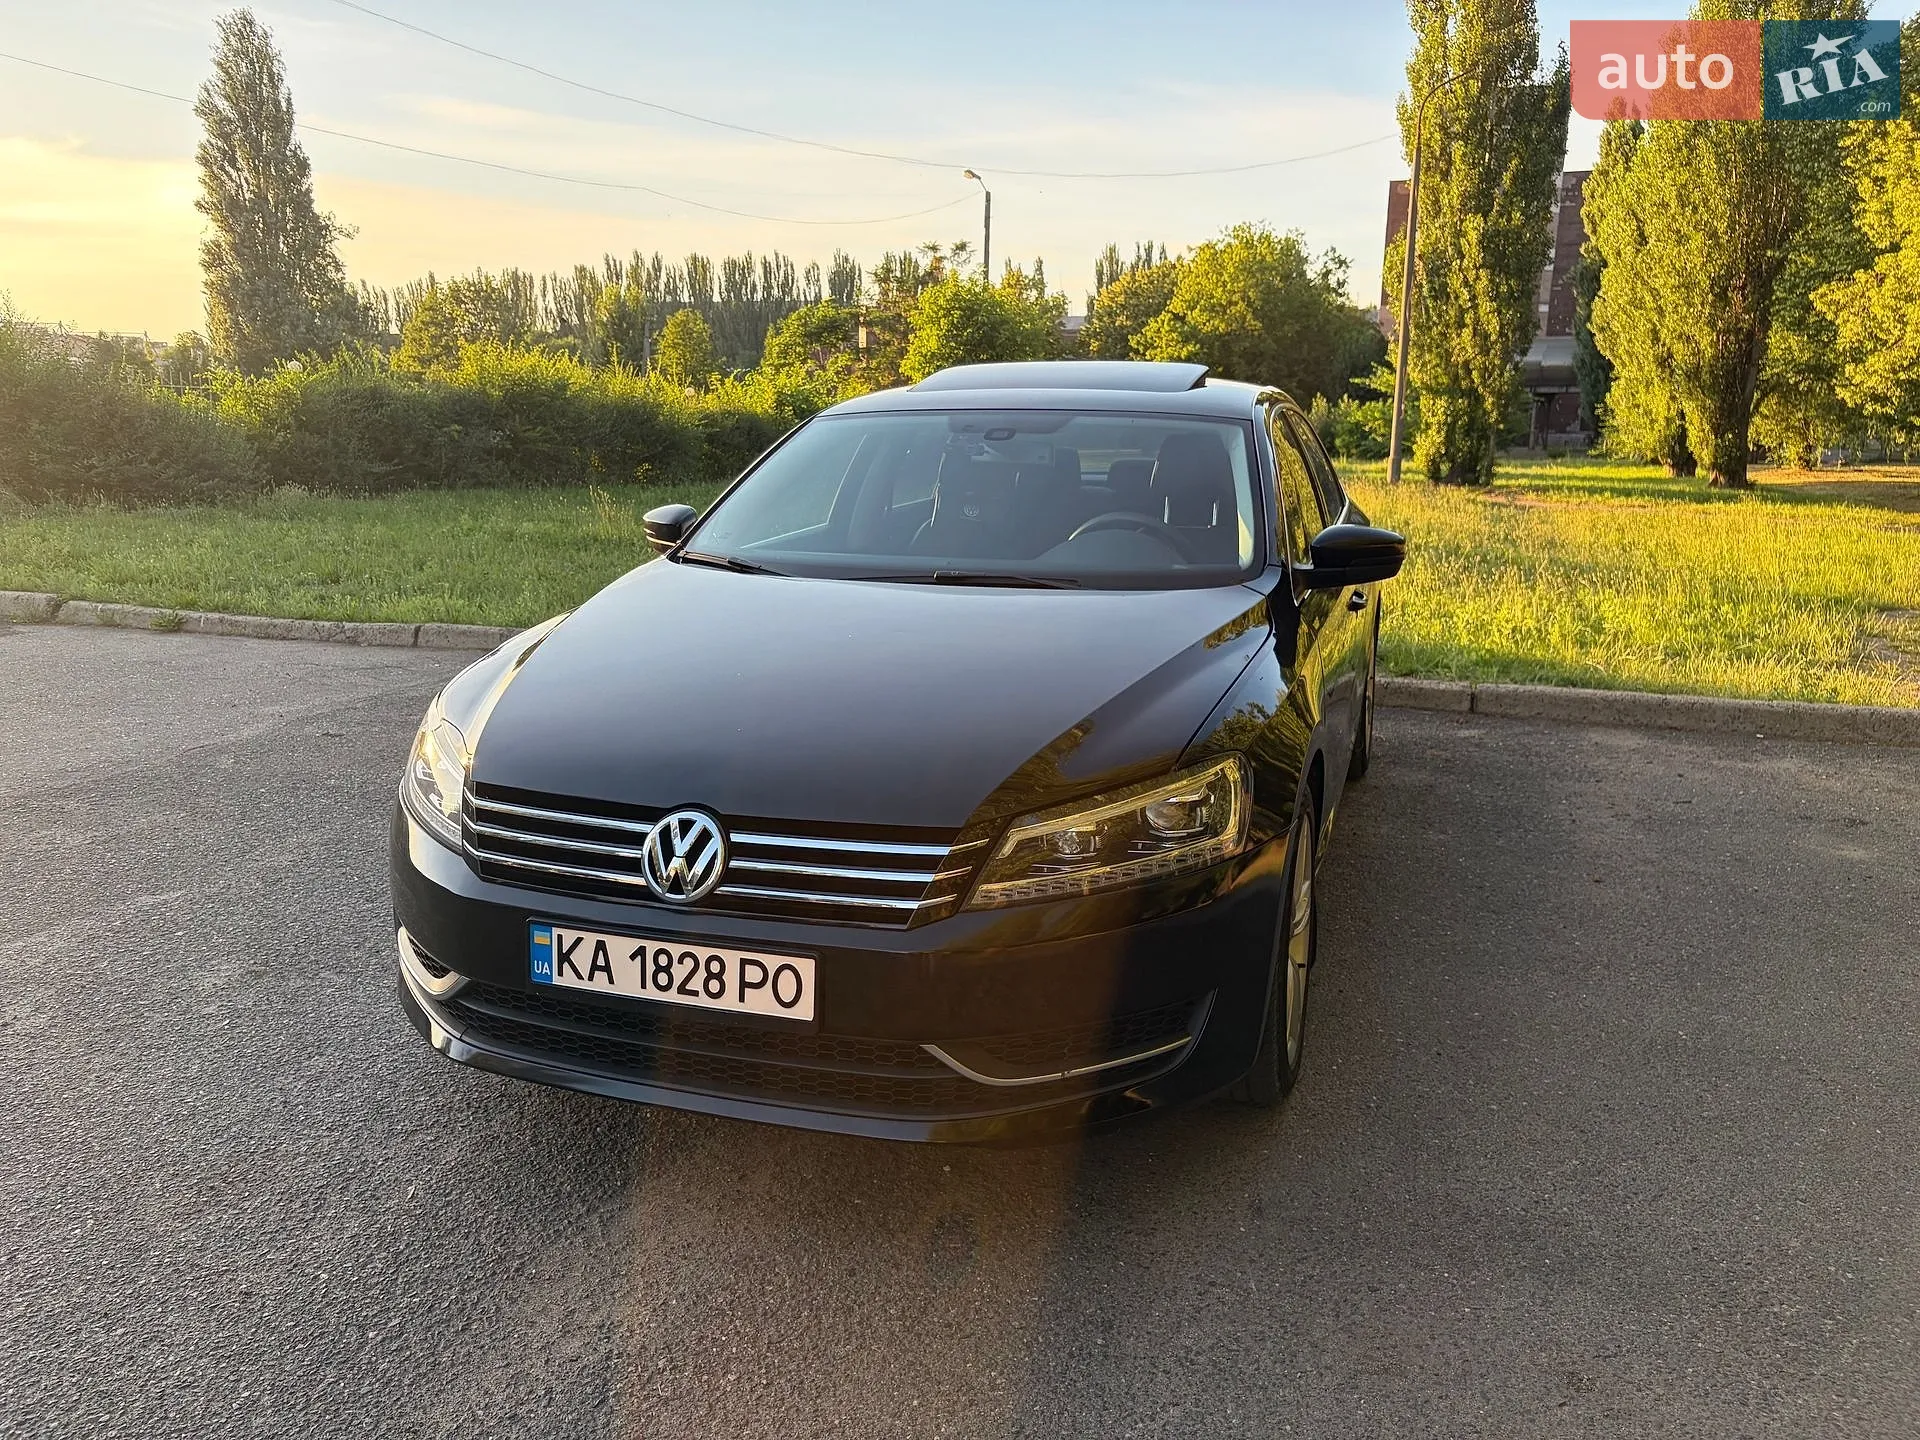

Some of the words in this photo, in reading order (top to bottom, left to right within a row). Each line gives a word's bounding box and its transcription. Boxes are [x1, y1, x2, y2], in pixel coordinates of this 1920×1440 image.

[534, 959, 551, 976] UA
[556, 933, 615, 985] KA
[628, 945, 727, 1000] 1828
[738, 957, 803, 1009] PO
